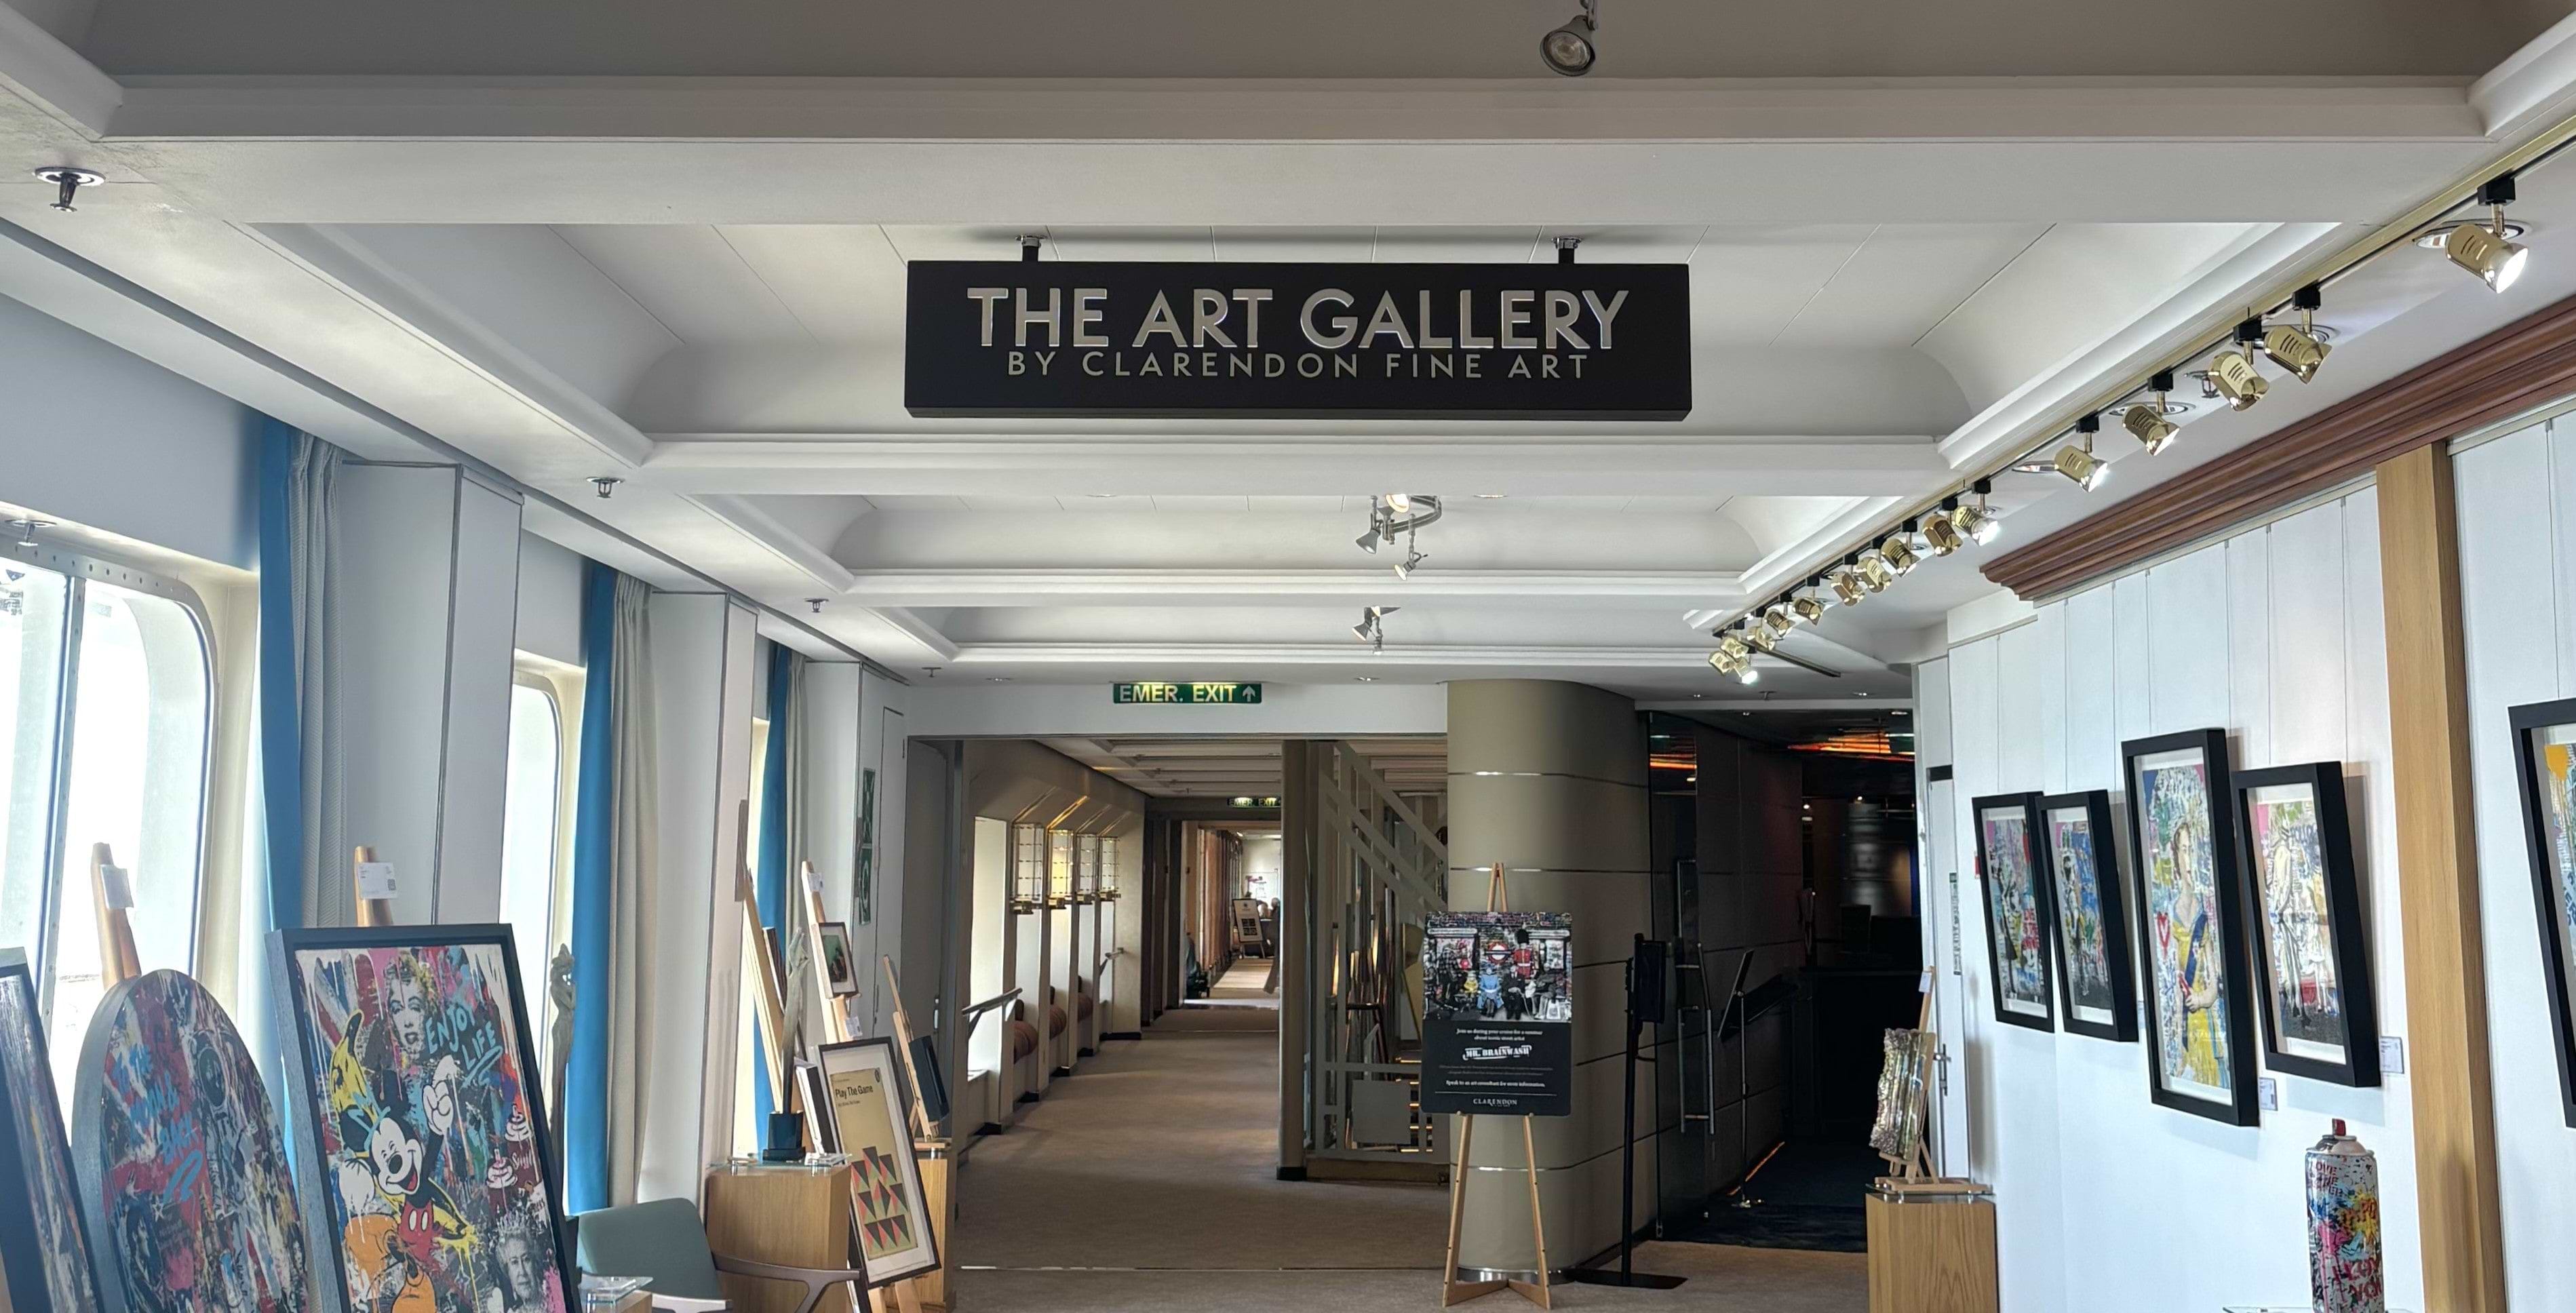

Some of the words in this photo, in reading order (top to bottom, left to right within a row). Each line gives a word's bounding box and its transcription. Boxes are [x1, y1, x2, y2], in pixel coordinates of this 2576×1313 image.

[967, 287, 1110, 347] THE
[1131, 288, 1274, 349] ART
[1300, 288, 1631, 349] GALLERY
[1007, 351, 1053, 376] BY
[1082, 351, 1359, 378] CLARENDON
[1386, 353, 1483, 378] FINE
[1507, 353, 1588, 379] ART
[1119, 684, 1184, 703] EMER.
[1192, 684, 1237, 703] EXIT
[1258, 796, 1277, 807] EXIT
[425, 1004, 475, 1055] ENJOY
[461, 1021, 496, 1072] LIFE
[1482, 1046, 1531, 1057] BRAINWASH
[835, 1088, 847, 1099] Play
[857, 1085, 874, 1095] Game
[1472, 1098, 1518, 1106] CLARENDON
